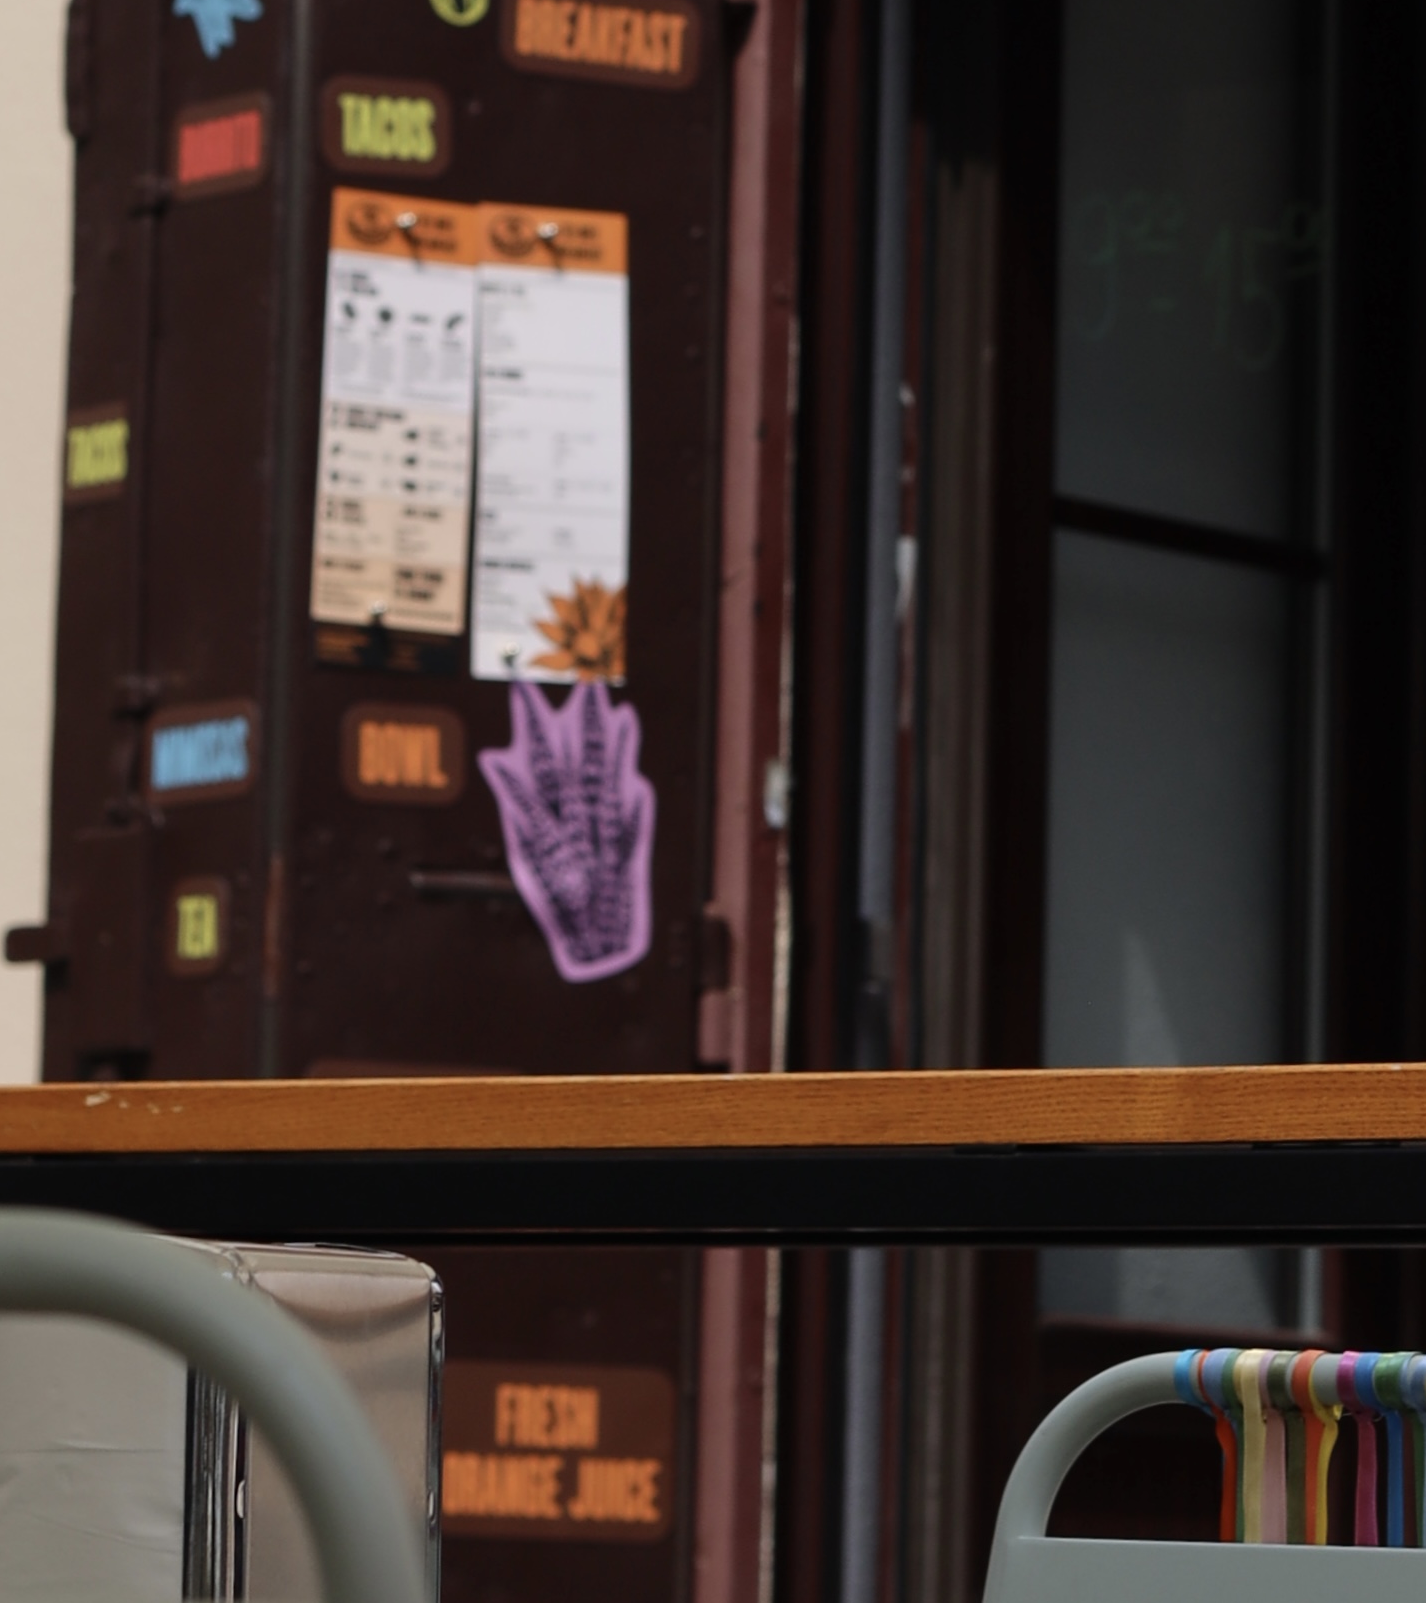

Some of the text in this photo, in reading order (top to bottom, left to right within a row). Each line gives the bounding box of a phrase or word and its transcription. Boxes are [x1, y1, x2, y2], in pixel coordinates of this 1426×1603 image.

[339, 92, 437, 163] TACOS
[357, 720, 450, 788] BOWL
[495, 1382, 600, 1450] FRESH
[442, 1450, 663, 1524] ORANGE JUICE
